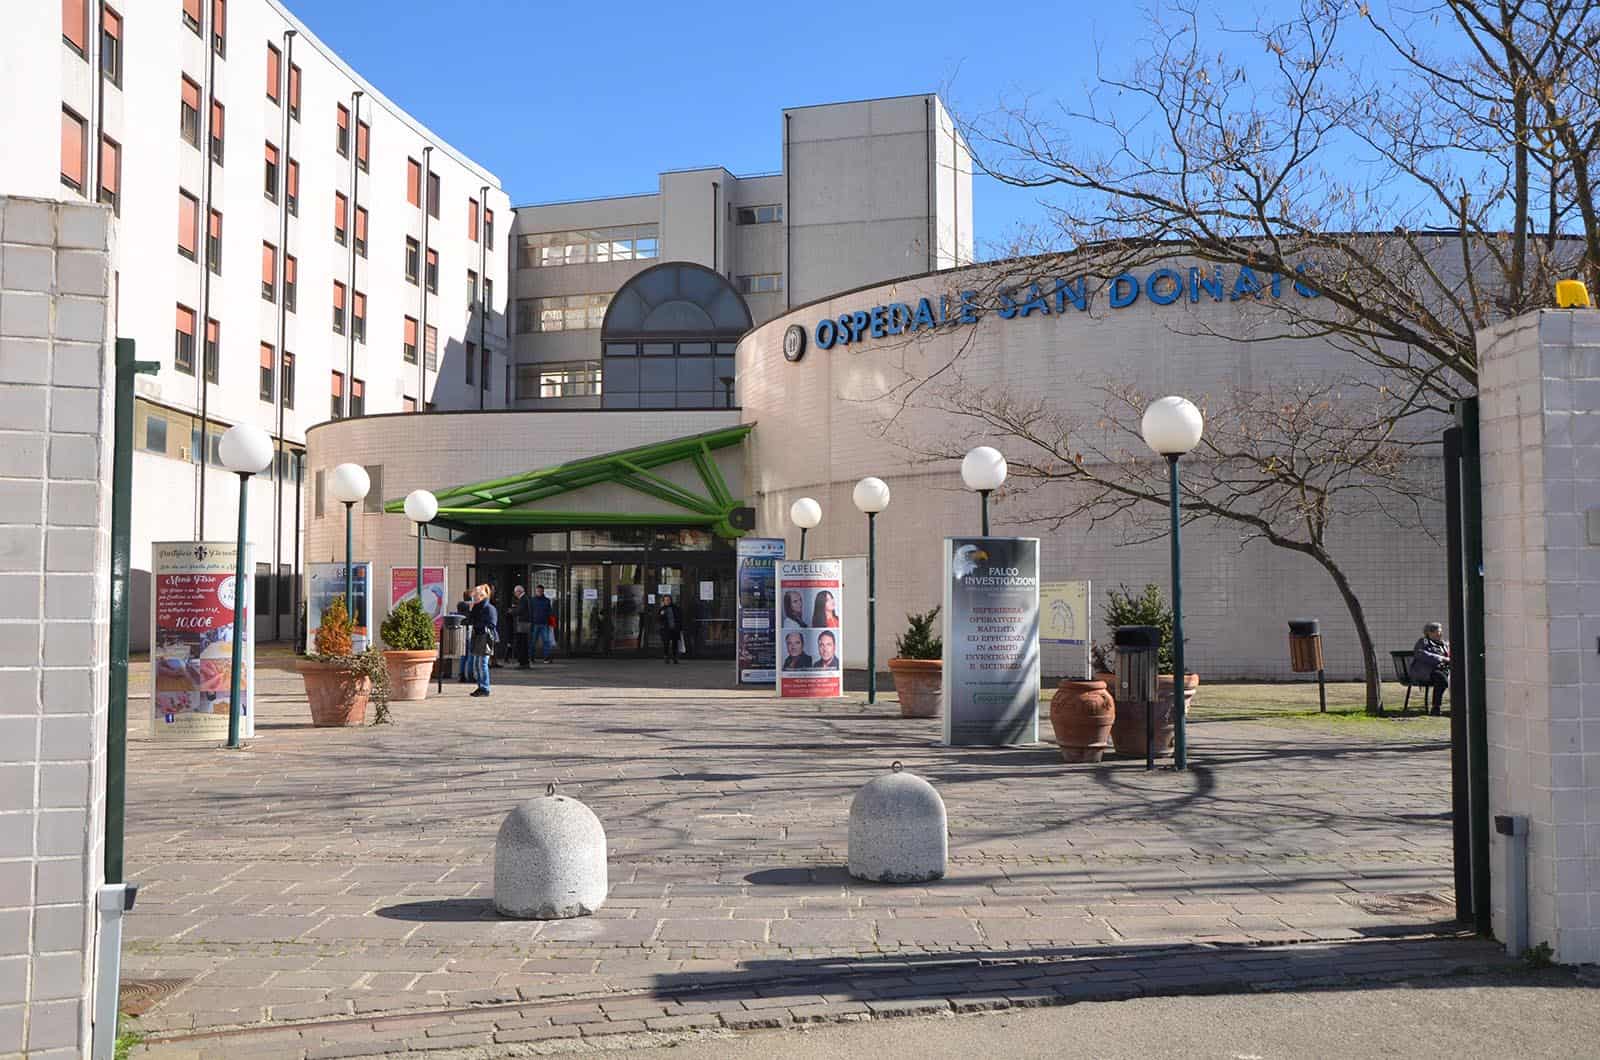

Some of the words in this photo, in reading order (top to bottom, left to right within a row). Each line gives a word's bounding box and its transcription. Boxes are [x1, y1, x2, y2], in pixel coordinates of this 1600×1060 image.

[815, 289, 978, 350] OSPEDALE
[998, 274, 1088, 320] SAN
[782, 564, 823, 574] CAPELLI
[988, 567, 1020, 576] FALCO
